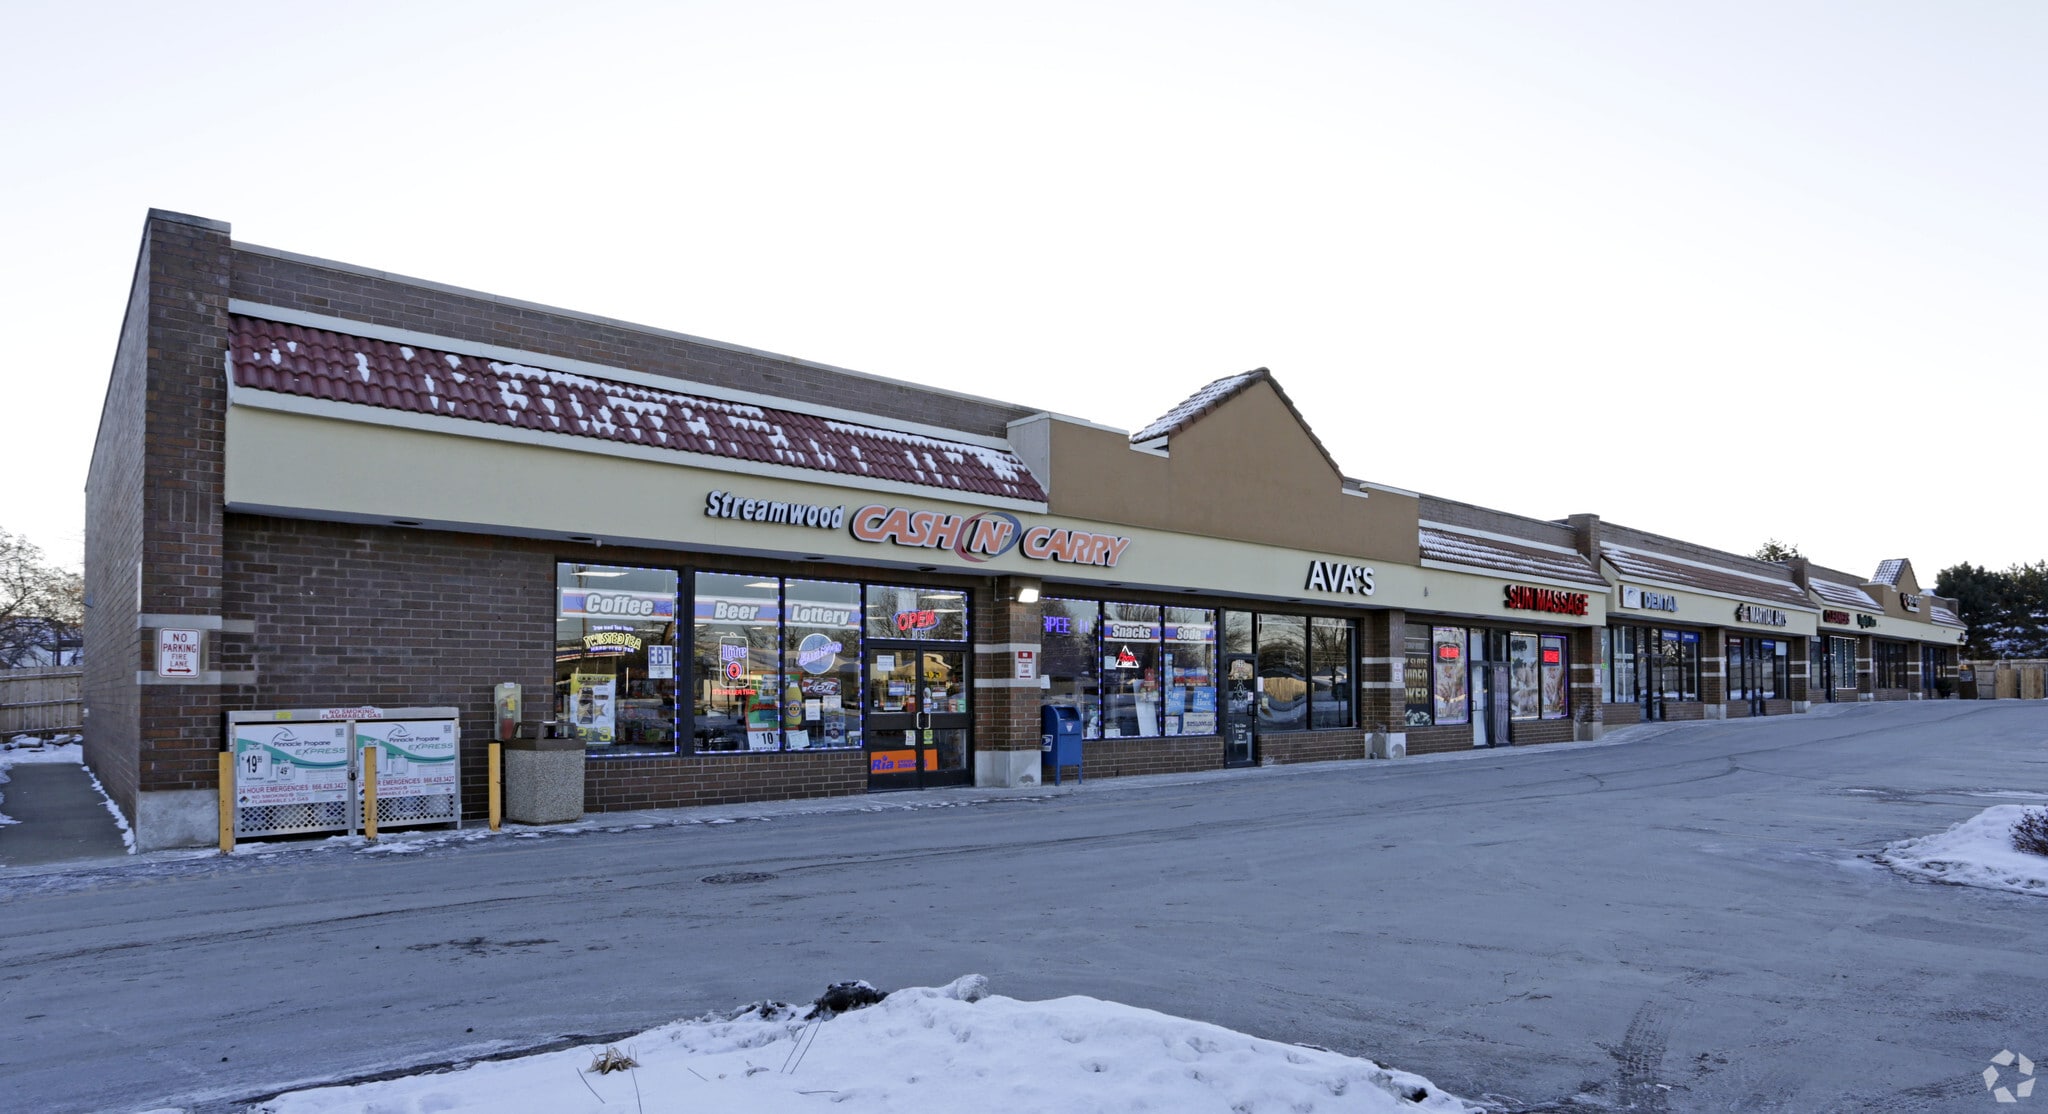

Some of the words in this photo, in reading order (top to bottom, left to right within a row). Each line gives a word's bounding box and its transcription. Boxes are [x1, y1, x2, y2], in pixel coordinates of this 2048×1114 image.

[704, 490, 845, 529] Streamwood
[849, 504, 962, 549] CASH
[1021, 526, 1130, 567] CARRY
[1306, 560, 1375, 596] AVA'S
[585, 593, 653, 616] Coffee
[1506, 584, 1534, 610] SUN
[1537, 588, 1589, 616] MASSAGE
[1643, 591, 1678, 612] DENTAL
[713, 600, 759, 620] Beer
[791, 604, 850, 627] Lottery
[898, 609, 935, 631] OPEN
[173, 633, 187, 642] NO
[583, 632, 624, 649] TWISTED
[625, 633, 641, 650] TEA
[1111, 624, 1152, 640] Snacks
[1176, 626, 1201, 640] Soda
[163, 644, 197, 653] PARKING
[649, 647, 671, 664] EBT
[408, 743, 453, 751] EXPRESS
[761, 732, 774, 745] 10
[295, 747, 346, 756] EXPRESS
[246, 755, 258, 773] 19
[872, 755, 894, 770] Ria
